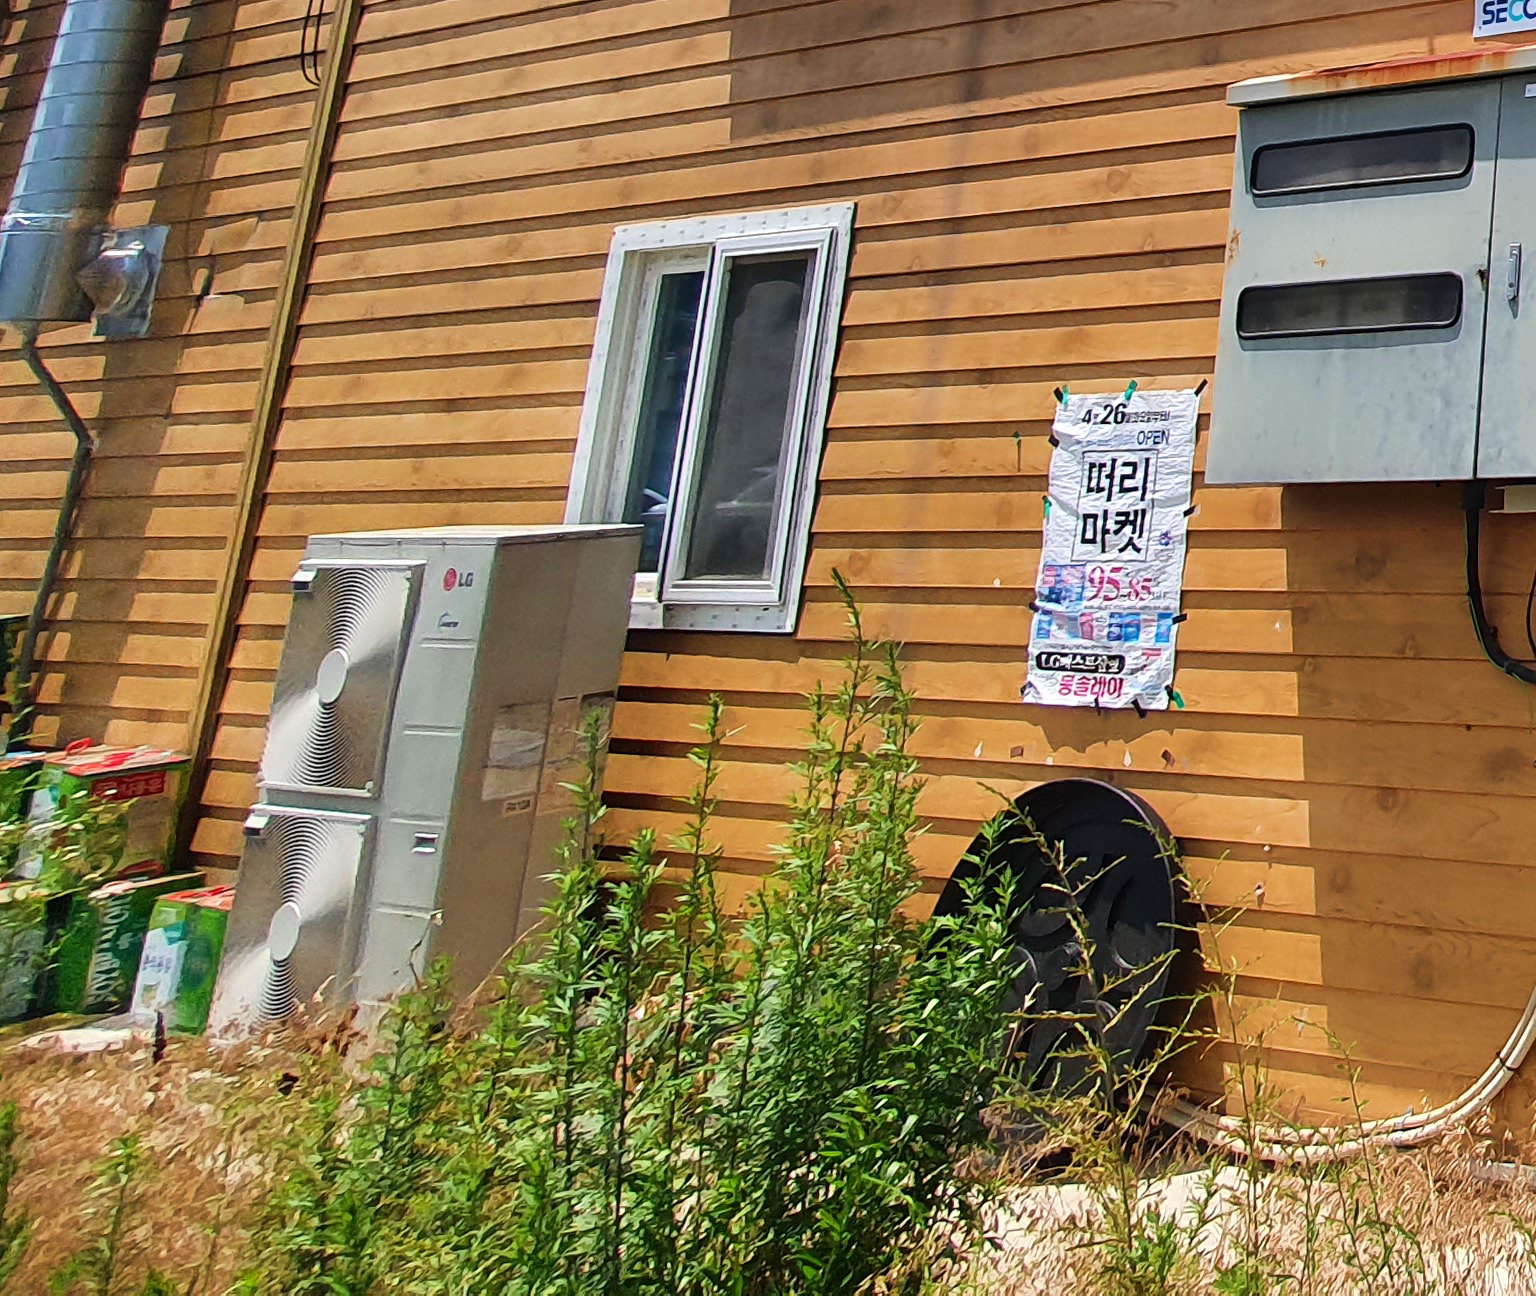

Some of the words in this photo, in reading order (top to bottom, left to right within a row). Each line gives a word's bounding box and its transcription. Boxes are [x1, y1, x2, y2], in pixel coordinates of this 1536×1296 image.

[1137, 429, 1170, 445] OPEN
[1086, 457, 1151, 502] 떠리
[1080, 508, 1147, 554] 마켓
[458, 572, 474, 588] LG
